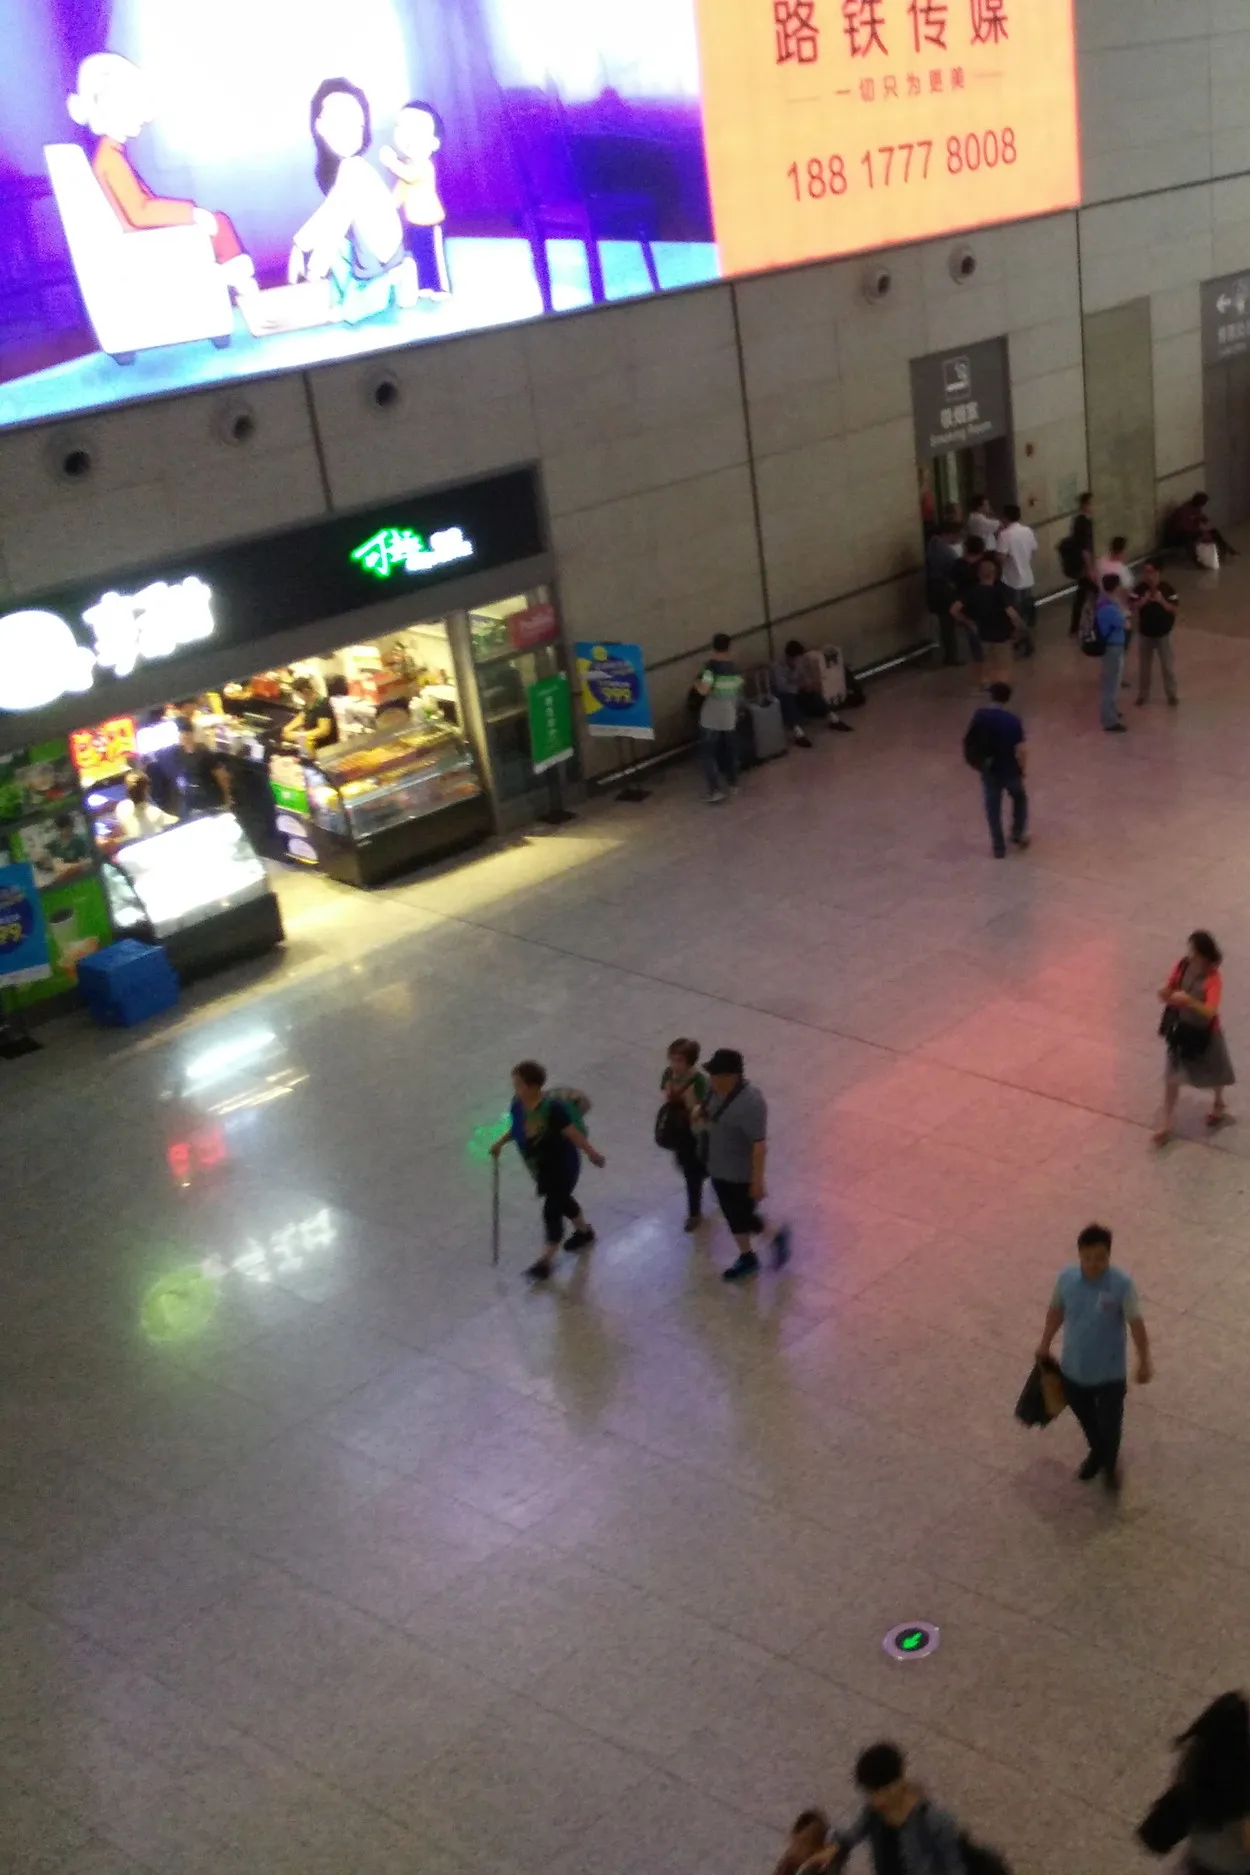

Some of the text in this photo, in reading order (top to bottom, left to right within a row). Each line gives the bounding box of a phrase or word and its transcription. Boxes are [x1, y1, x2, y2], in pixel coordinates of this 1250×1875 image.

[772, 0, 1009, 65] 路铁传媒
[787, 126, 1017, 201] 188 1777 8008
